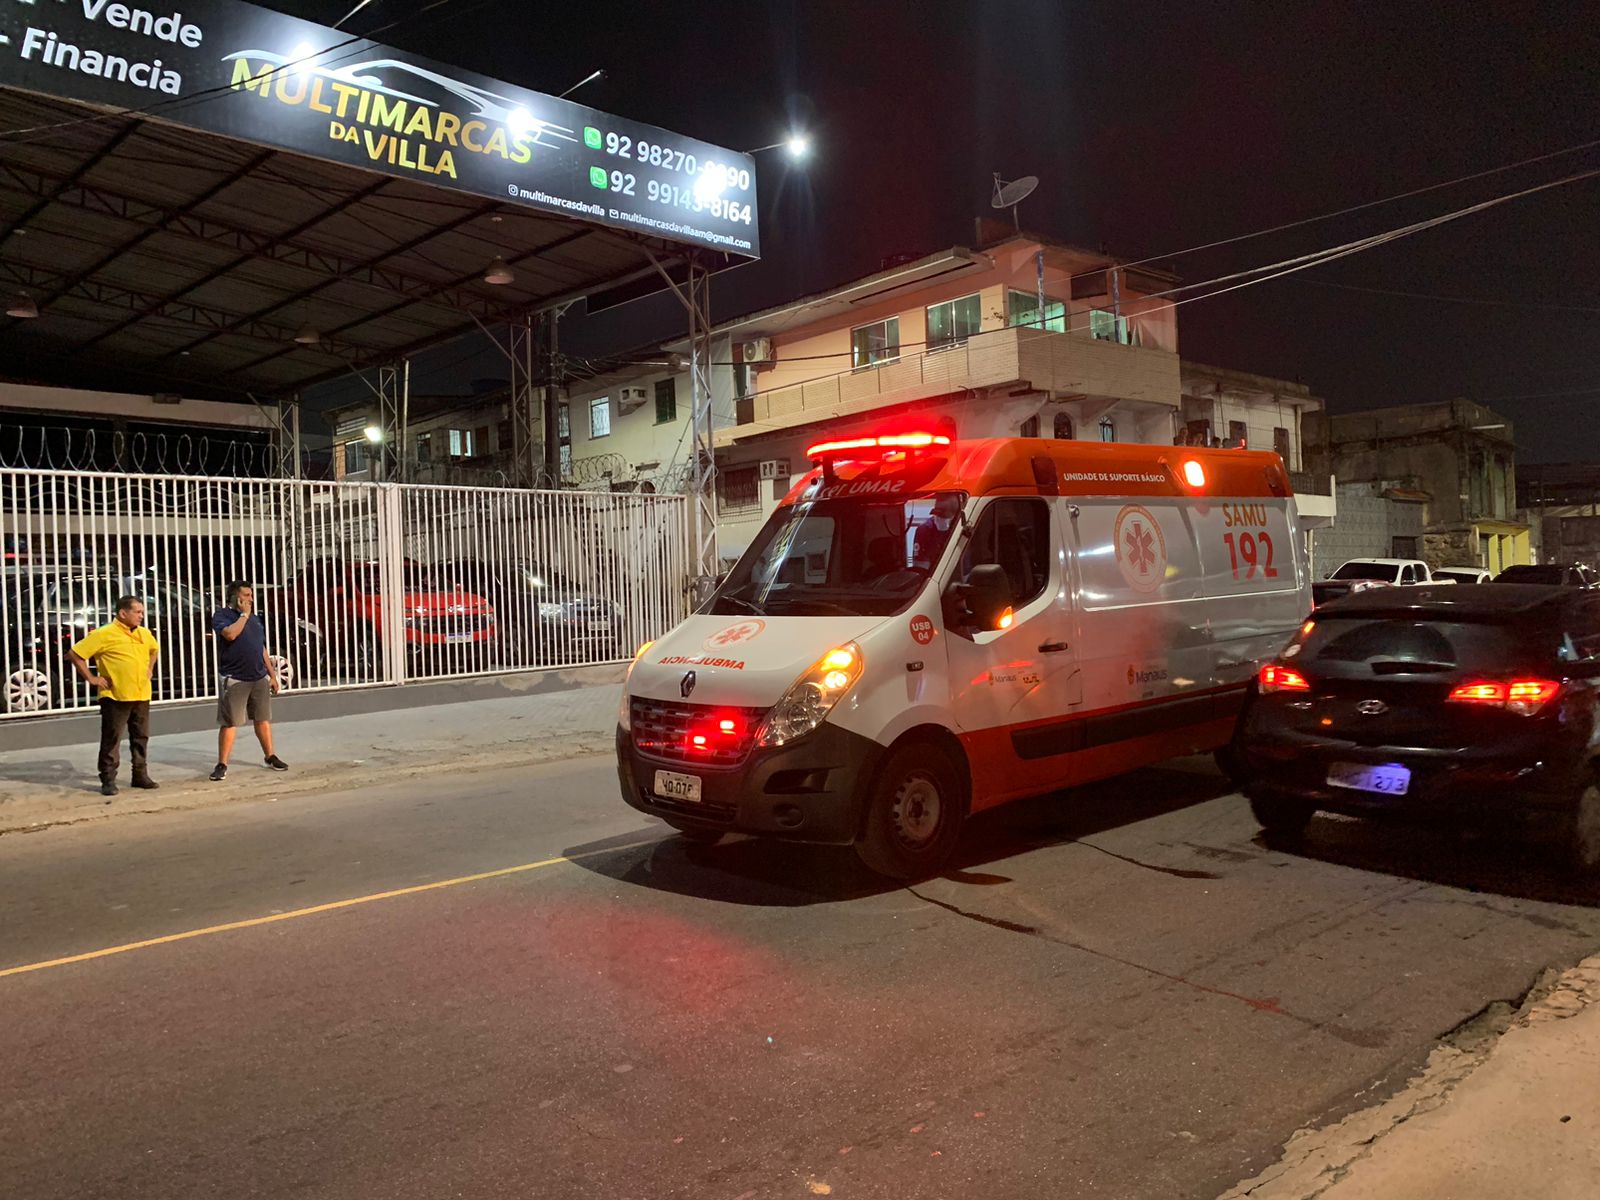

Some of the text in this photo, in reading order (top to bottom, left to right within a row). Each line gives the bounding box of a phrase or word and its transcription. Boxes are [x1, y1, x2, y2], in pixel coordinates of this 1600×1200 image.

[82, 0, 203, 48] Vende
[20, 27, 182, 95] Financia
[230, 57, 532, 163] MULTIMARCAS
[329, 121, 458, 179] DA VILLA
[605, 132, 632, 159] 92
[610, 170, 636, 196] 92
[519, 189, 751, 250] multimarcasdavilla multimarcasdavillaam@gmail.com
[1063, 472, 1166, 482] UNIDADE DE SUPORTE BÁSICO
[1222, 502, 1267, 528] SAMU
[1223, 531, 1278, 581] 192
[911, 621, 931, 632] USB
[918, 631, 929, 641] 04
